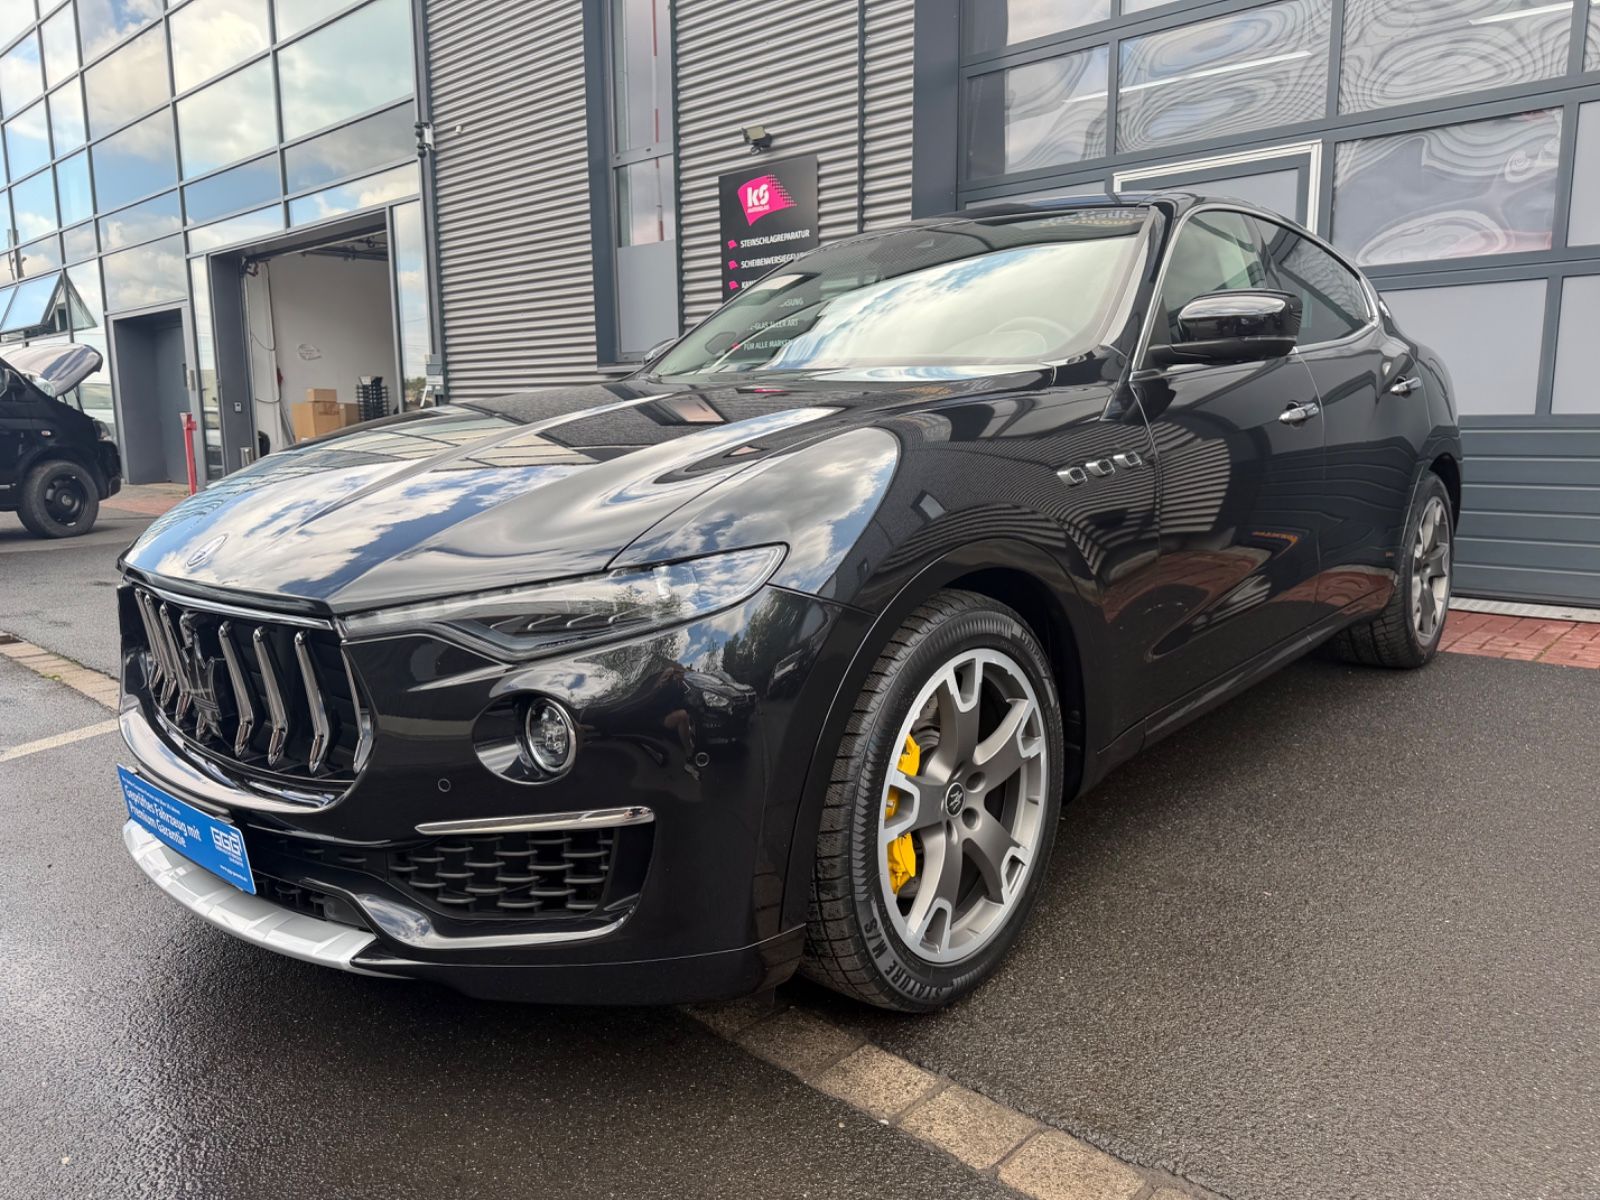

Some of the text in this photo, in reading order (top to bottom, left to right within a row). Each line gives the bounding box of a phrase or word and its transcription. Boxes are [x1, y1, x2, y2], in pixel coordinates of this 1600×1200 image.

[740, 230, 810, 249] STEINSCHLAGREPARATUR
[754, 341, 769, 350] ALLE
[884, 961, 943, 998] STATURE
